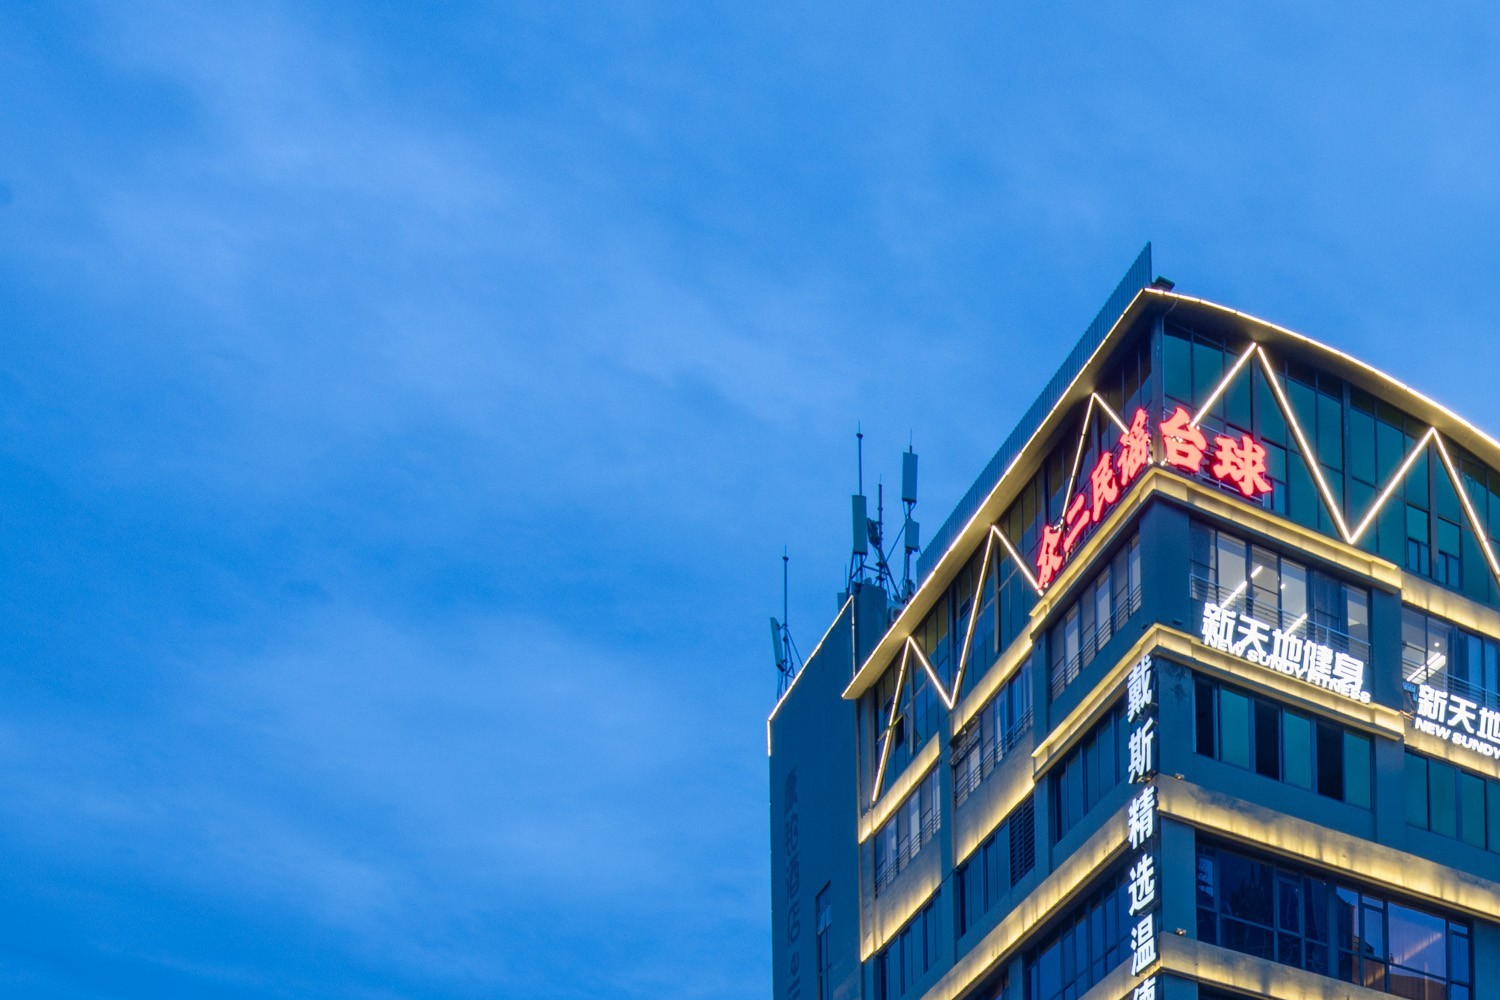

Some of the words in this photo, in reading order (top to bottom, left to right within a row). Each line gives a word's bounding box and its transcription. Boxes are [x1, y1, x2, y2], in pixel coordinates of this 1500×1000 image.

[1160, 406, 1272, 497] 台球
[1037, 408, 1150, 589] 众二民谣
[1202, 602, 1364, 690] 新天地健身
[1204, 634, 1246, 657] NEW
[1247, 649, 1306, 678] SUNDY
[1306, 671, 1372, 704] FITNESS
[1414, 717, 1452, 740] NEW
